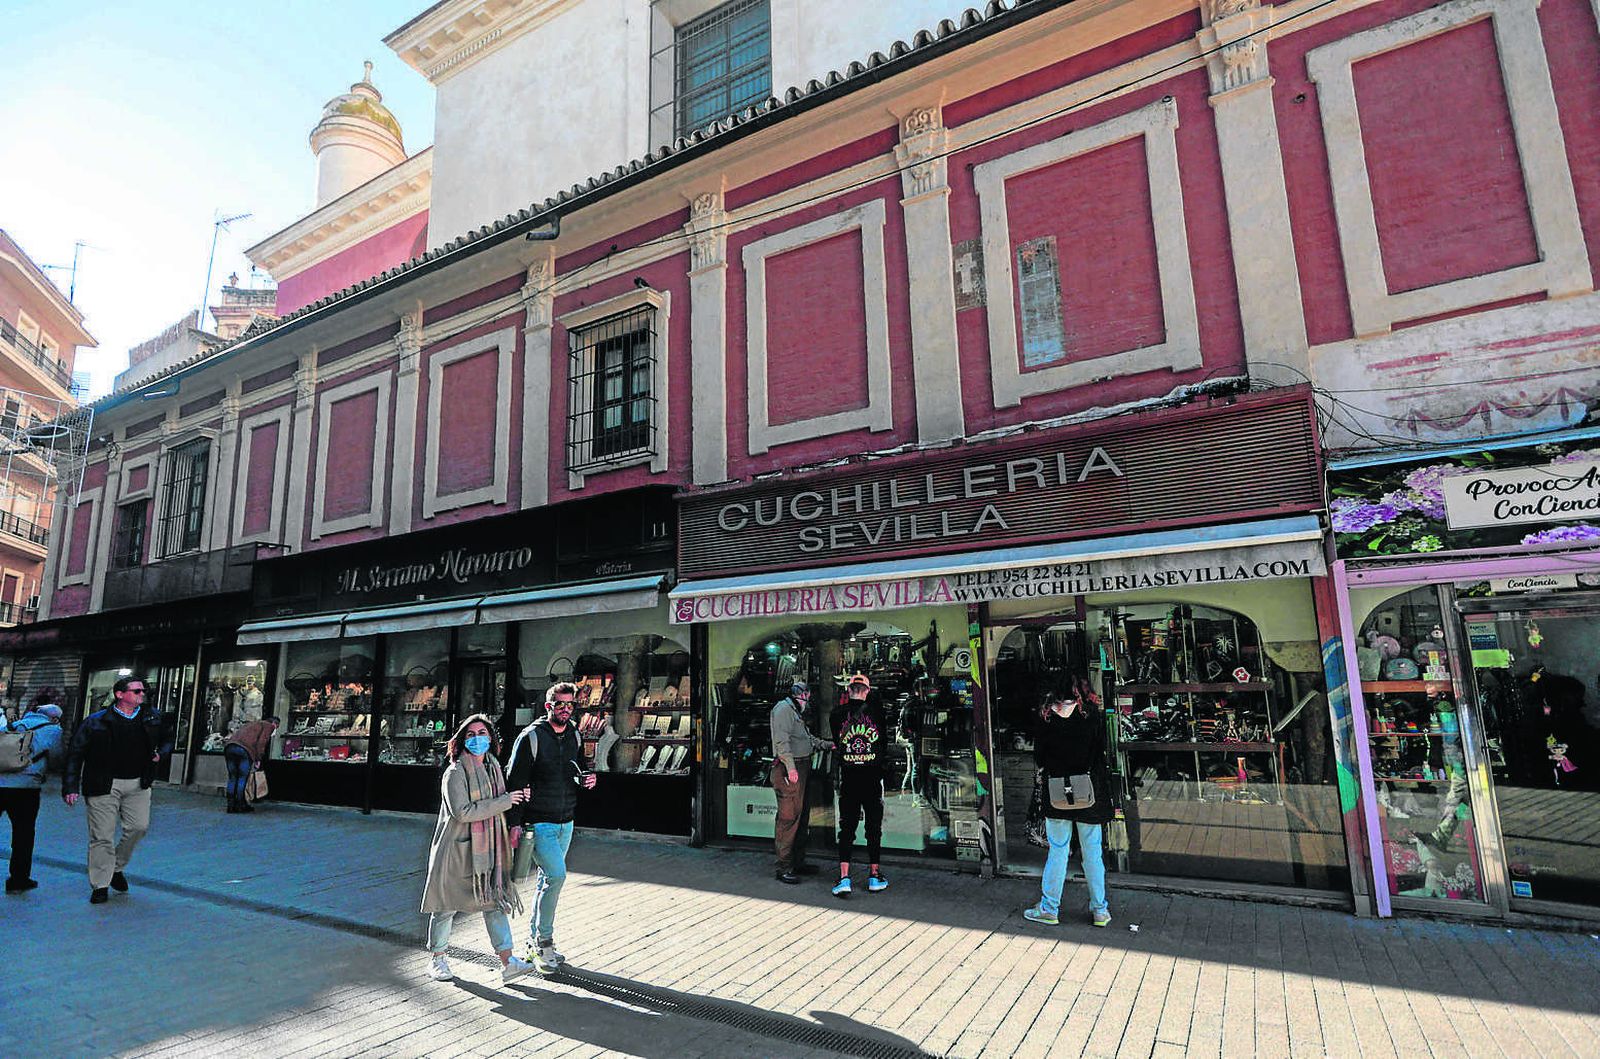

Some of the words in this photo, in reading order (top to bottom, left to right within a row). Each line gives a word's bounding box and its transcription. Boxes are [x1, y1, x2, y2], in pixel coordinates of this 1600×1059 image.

[718, 447, 1123, 531] CUCHILLERIA
[799, 504, 1009, 553] SEVILLA
[337, 567, 361, 594] M.
[364, 563, 435, 592] Serrano
[437, 547, 532, 583] Navarro
[953, 573, 999, 587] TELF.
[1003, 569, 1028, 583] 954
[1033, 567, 1050, 580] 22
[1053, 564, 1072, 578] 84
[1075, 562, 1092, 576] 21
[954, 559, 1311, 602] WWW.CUCHILLERIASEVILLA.COM
[1507, 578, 1558, 589] ConCiencia
[695, 585, 839, 619] CUCHILLERIA
[842, 577, 954, 610] SEVILLA
